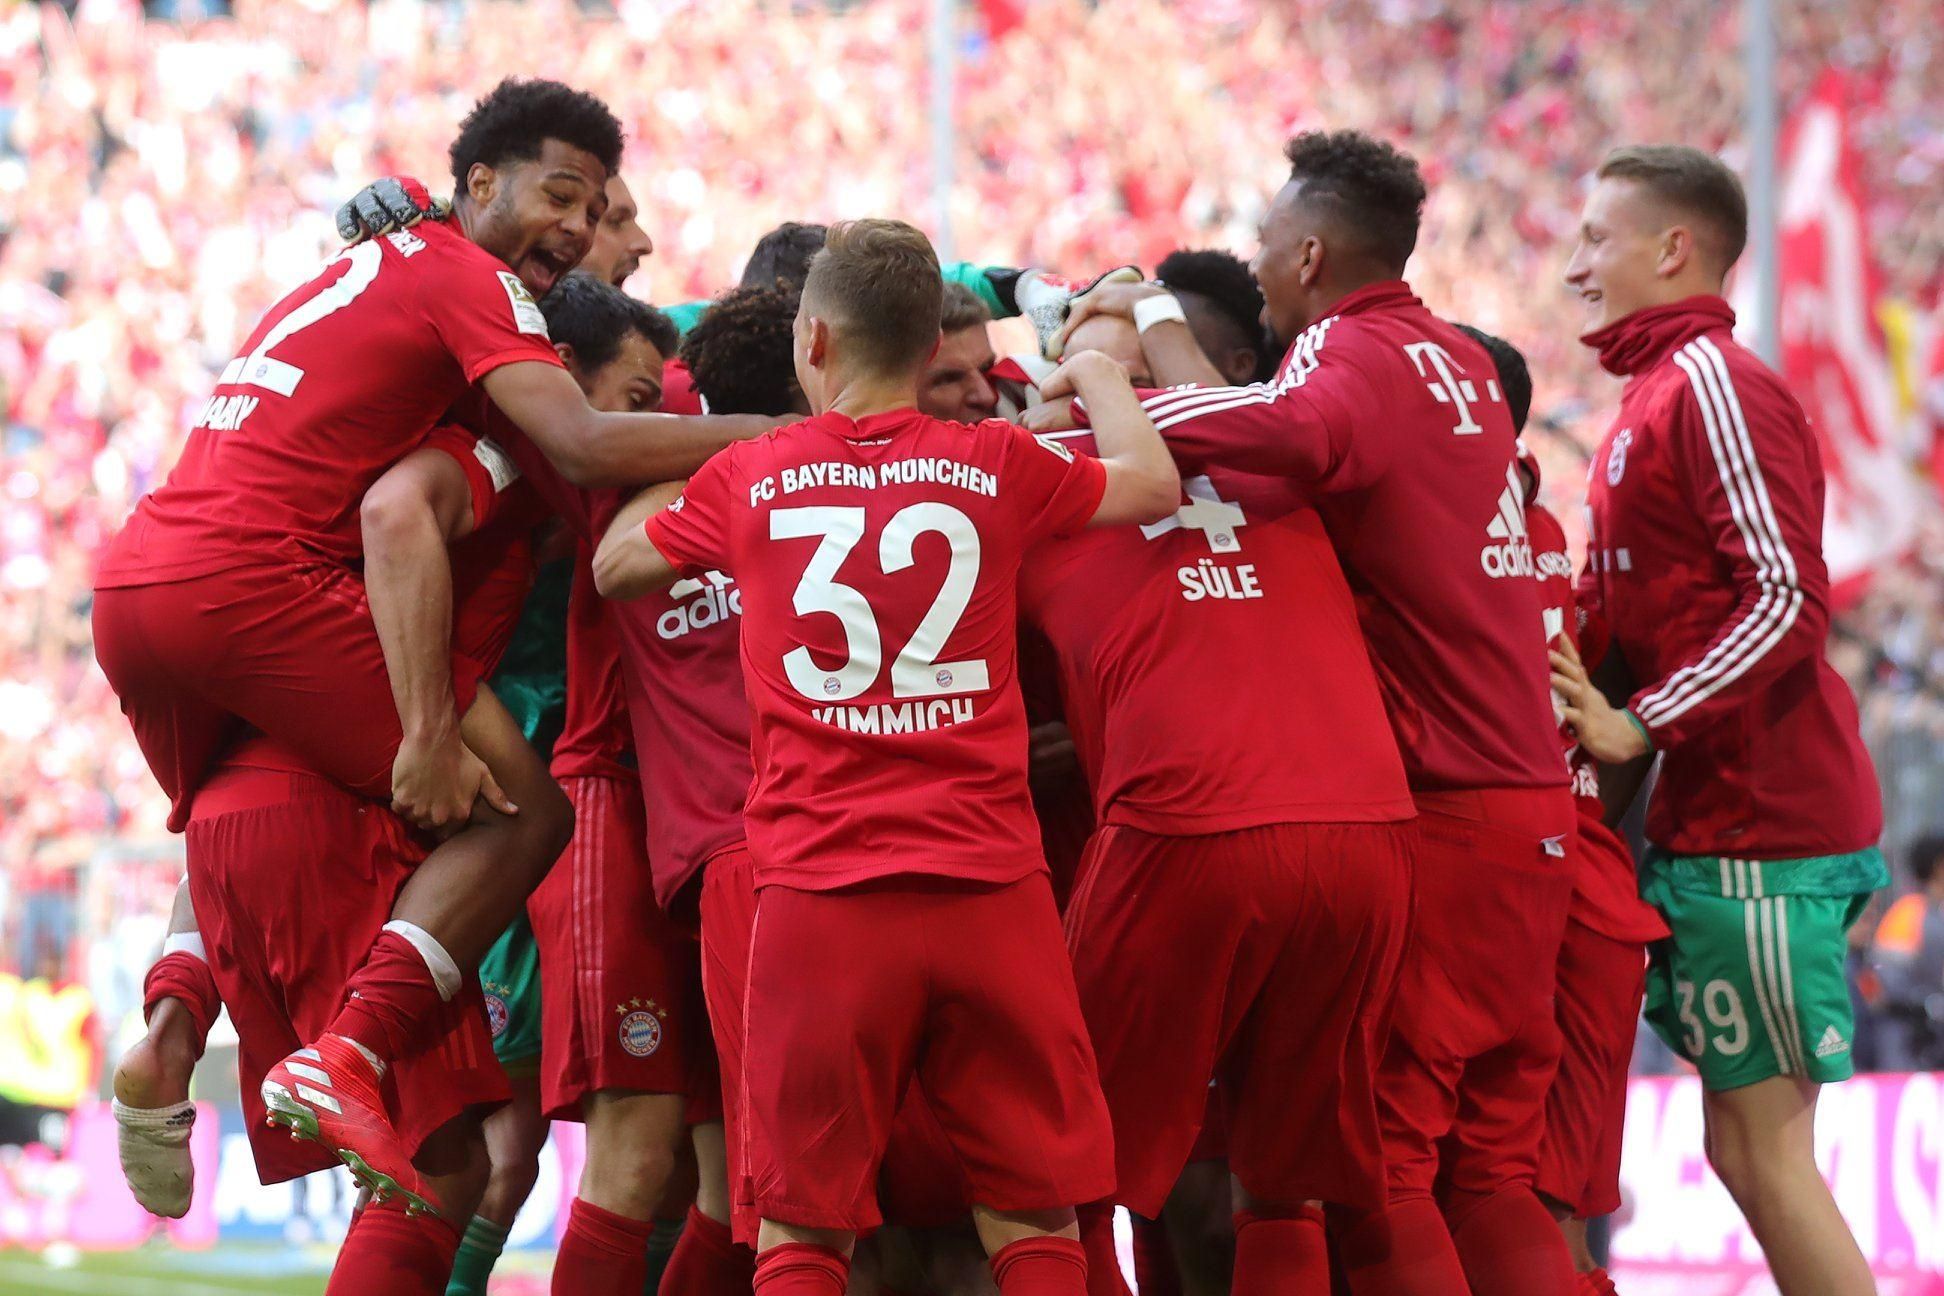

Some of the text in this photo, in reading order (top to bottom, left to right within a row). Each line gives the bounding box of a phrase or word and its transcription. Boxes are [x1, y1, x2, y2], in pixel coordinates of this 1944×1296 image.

[750, 457, 998, 508] FC BAYERN MÜNCHEN
[769, 501, 991, 701] 32
[1177, 557, 1264, 601] SÜLE
[811, 697, 975, 736] KIMMICH
[1676, 978, 1750, 1058] 39
